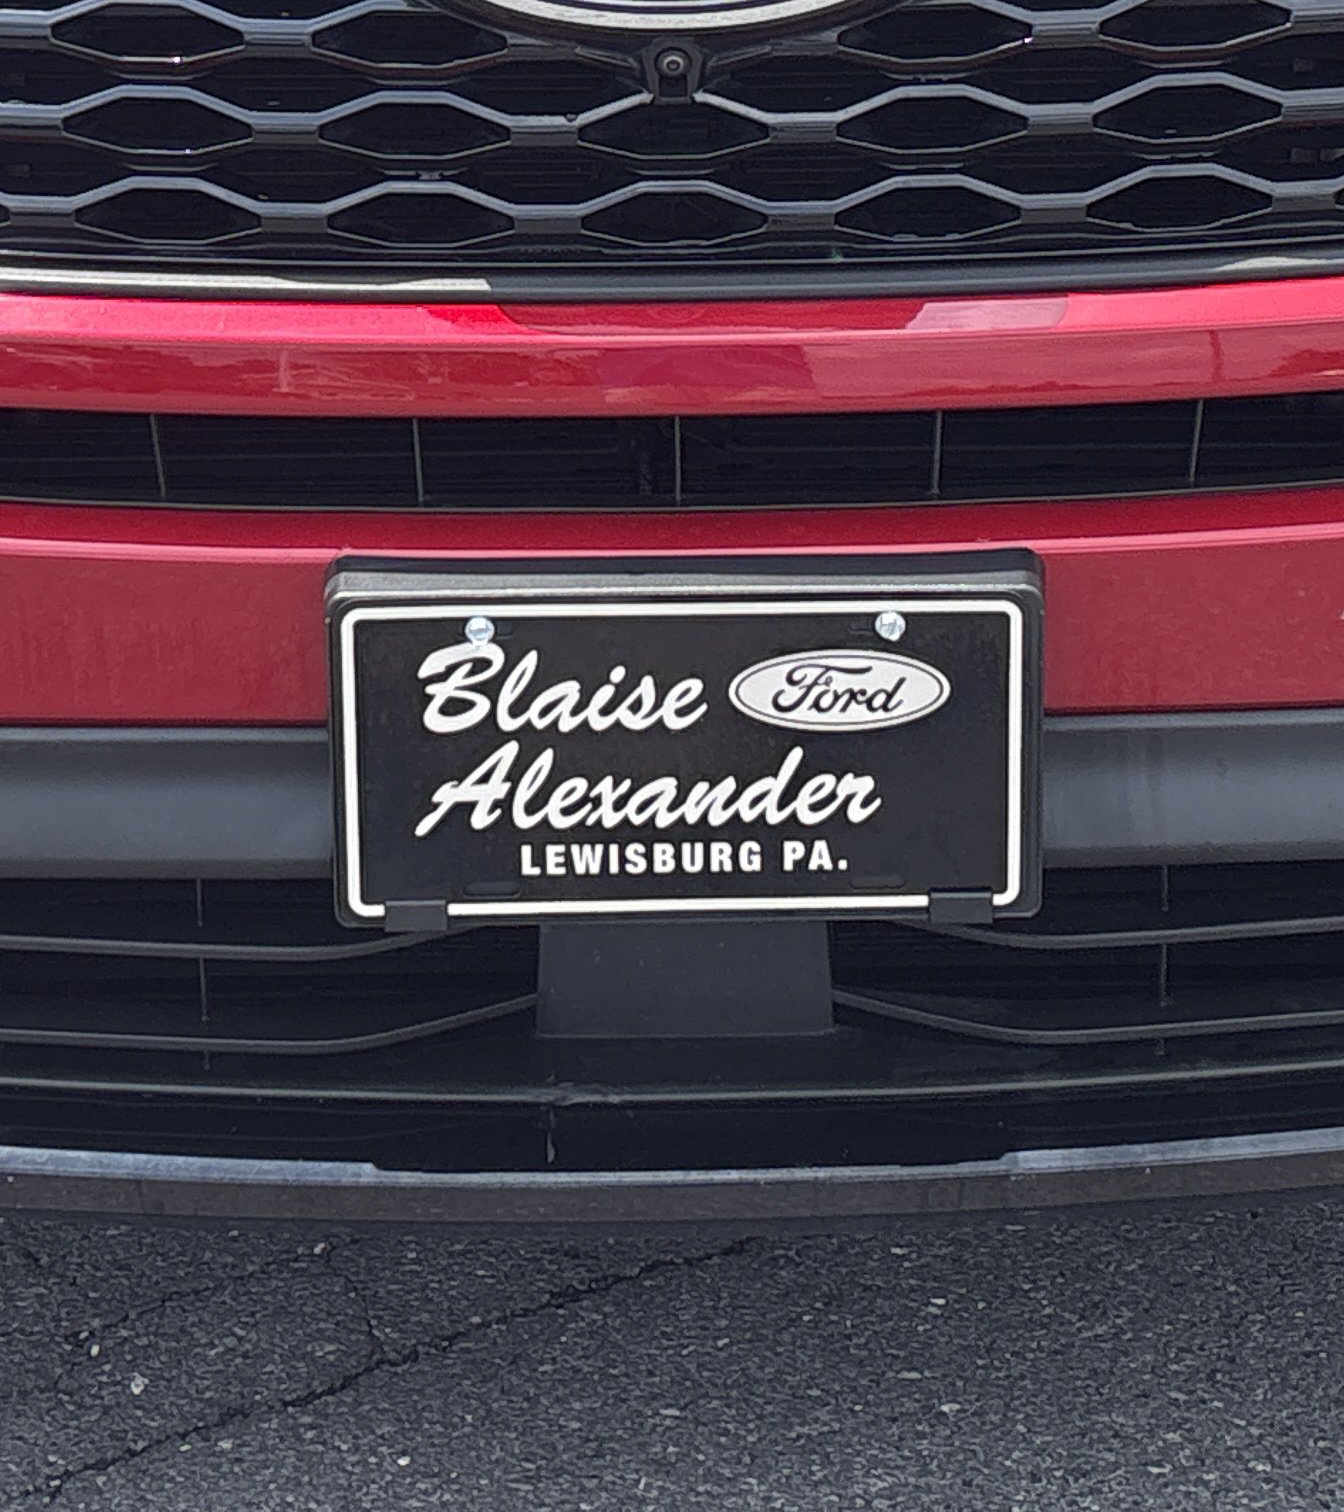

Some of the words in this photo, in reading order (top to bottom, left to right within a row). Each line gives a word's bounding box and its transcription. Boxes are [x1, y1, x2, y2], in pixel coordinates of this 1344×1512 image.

[416, 642, 708, 735] Blaise
[771, 662, 906, 714] Ford
[413, 740, 882, 838] Alexander
[520, 840, 764, 877] LEWISBURG
[782, 840, 849, 873] PA.
